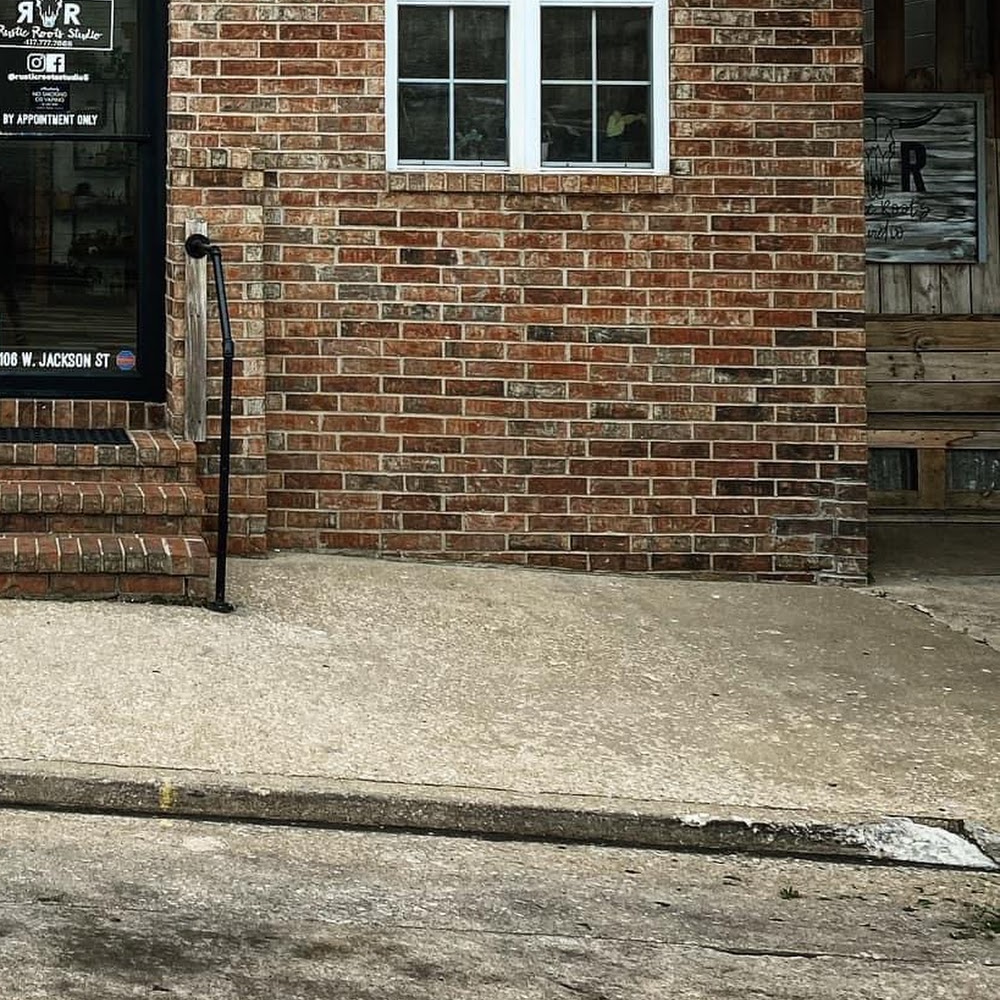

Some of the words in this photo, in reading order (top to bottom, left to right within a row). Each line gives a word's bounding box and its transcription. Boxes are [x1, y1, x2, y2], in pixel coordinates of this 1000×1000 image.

[63, 3, 81, 26] R
[32, 25, 65, 39] Roots
[67, 27, 103, 41] Studio
[3, 114, 14, 125] BY
[16, 114, 75, 126] APPOINTMENT
[77, 114, 98, 126] ONLY
[901, 141, 927, 192] R
[0, 352, 18, 367] 106
[22, 352, 36, 367] W.
[39, 352, 92, 368] JACKSON
[95, 353, 110, 368] ST
